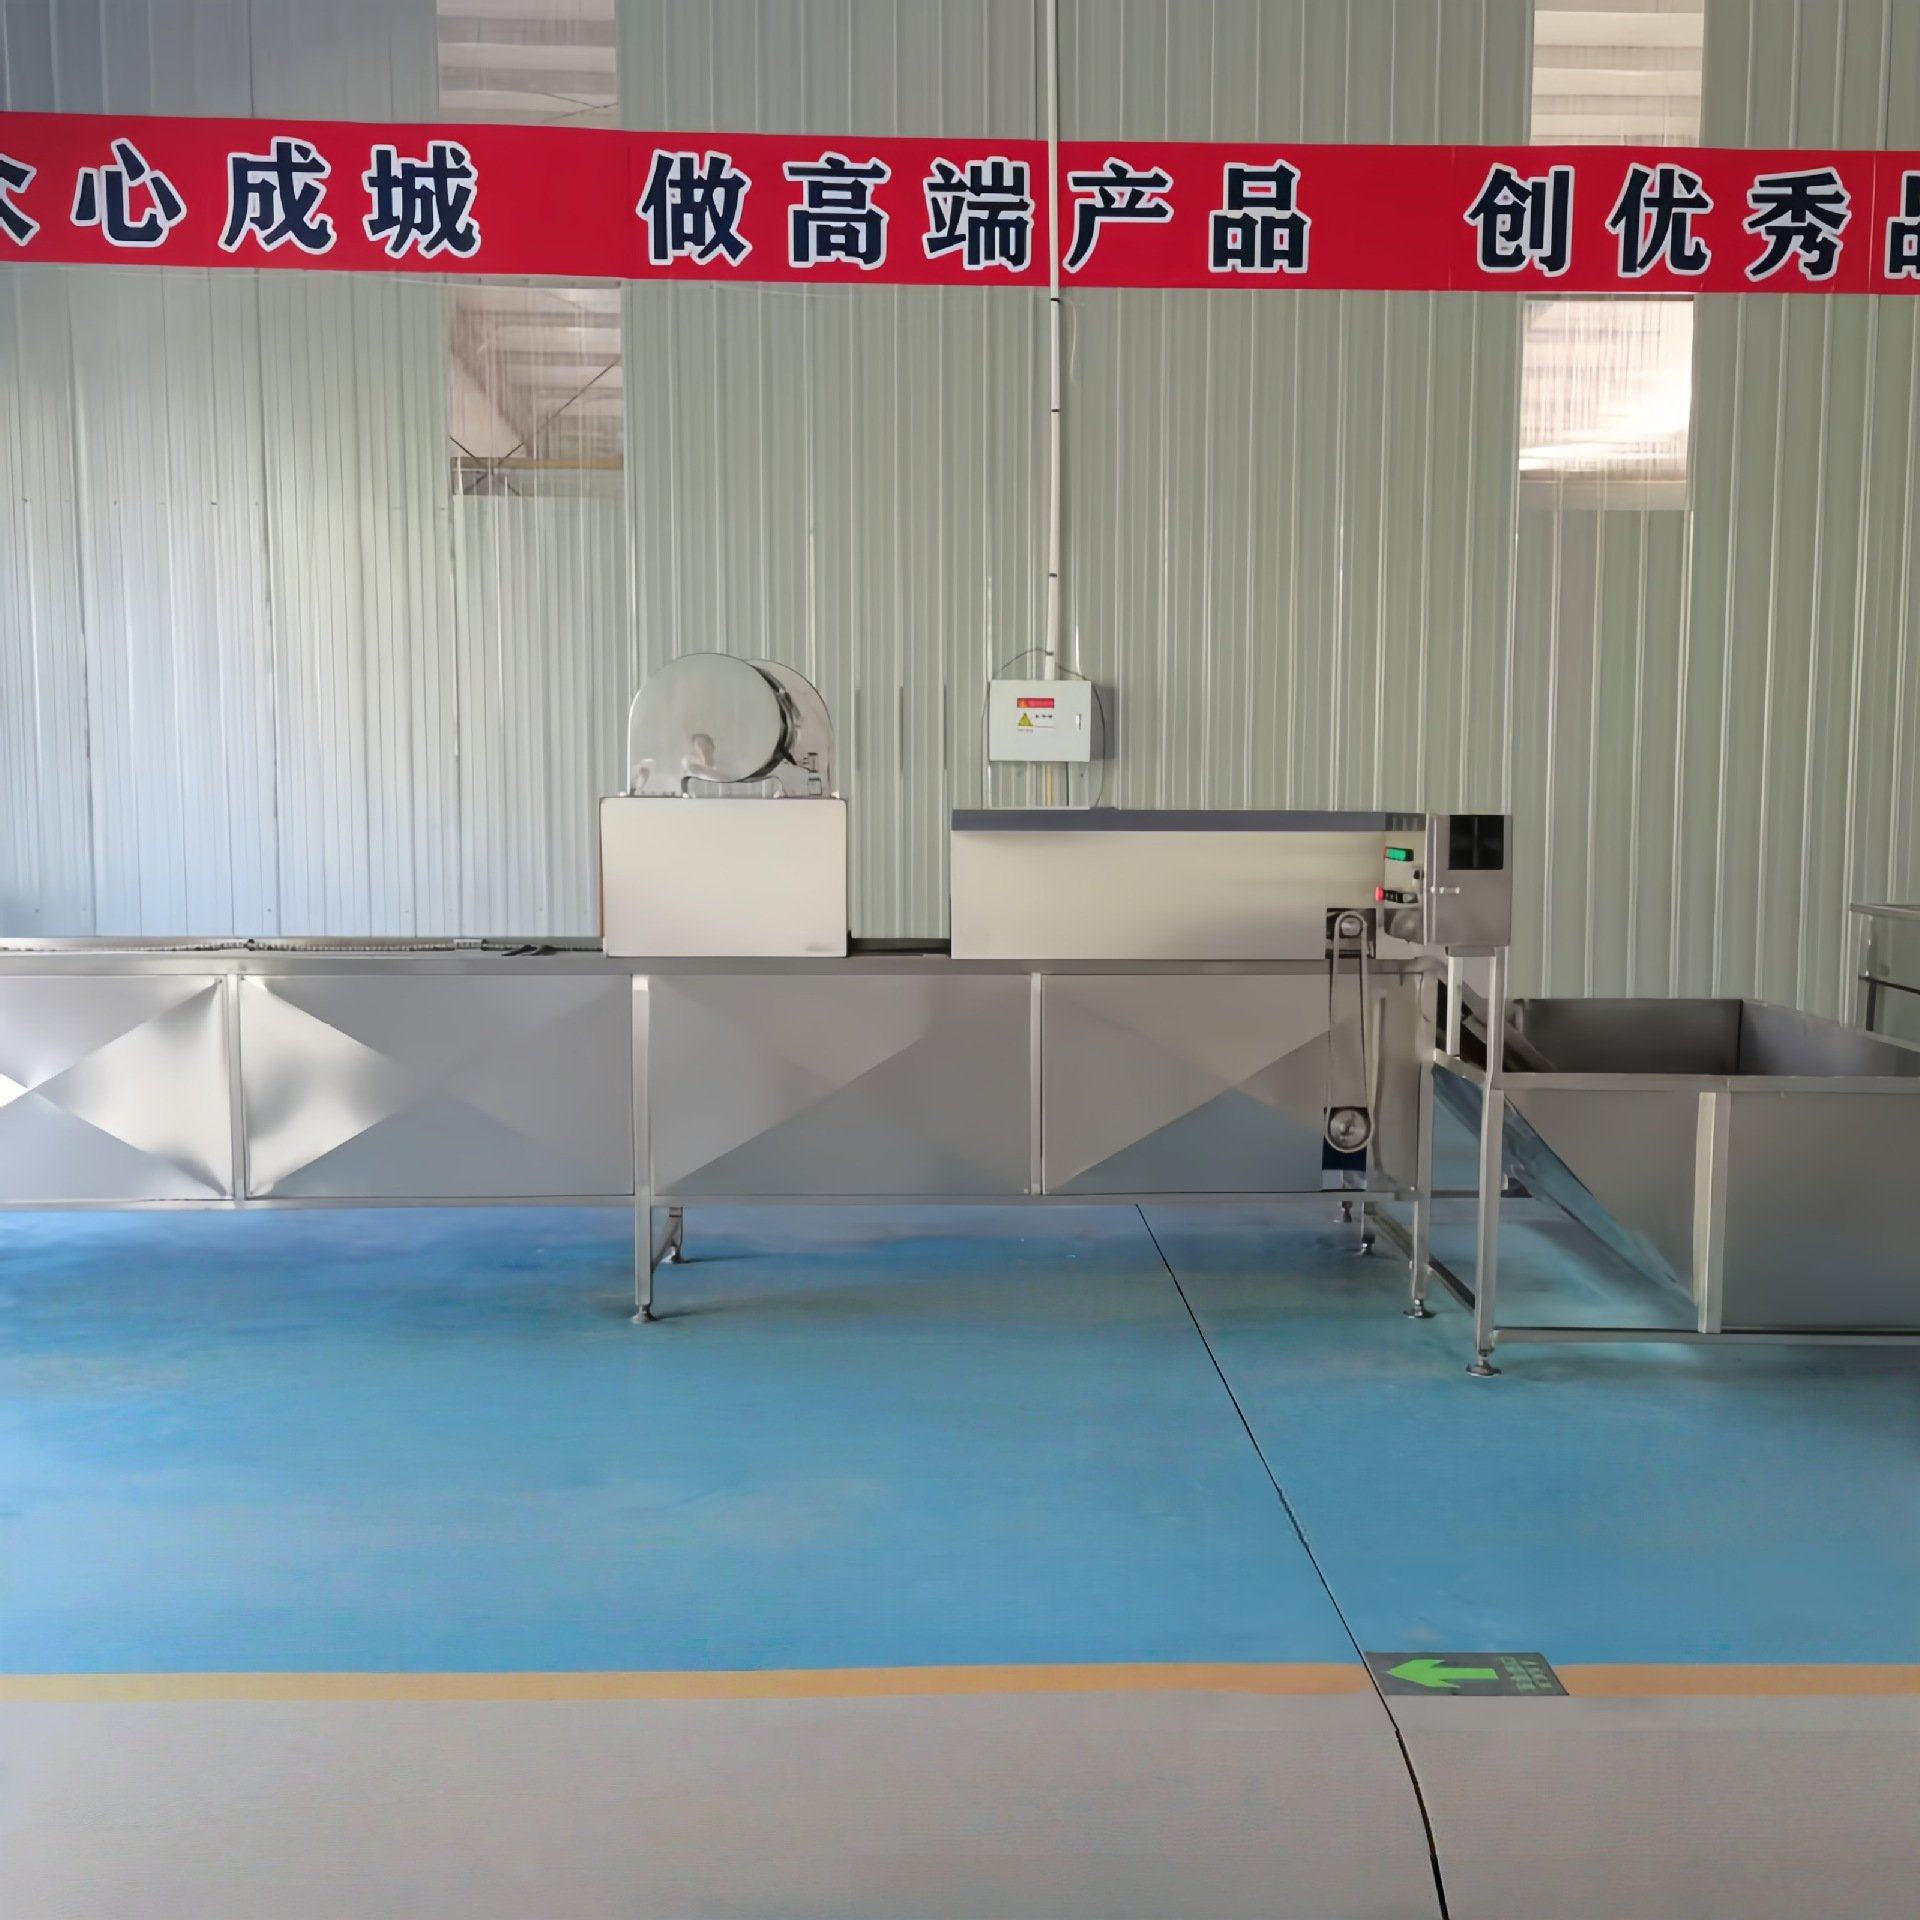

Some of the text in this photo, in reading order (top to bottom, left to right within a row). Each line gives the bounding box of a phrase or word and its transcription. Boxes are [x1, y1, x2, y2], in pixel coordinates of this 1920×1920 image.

[636, 149, 1311, 273] 做高端产品
